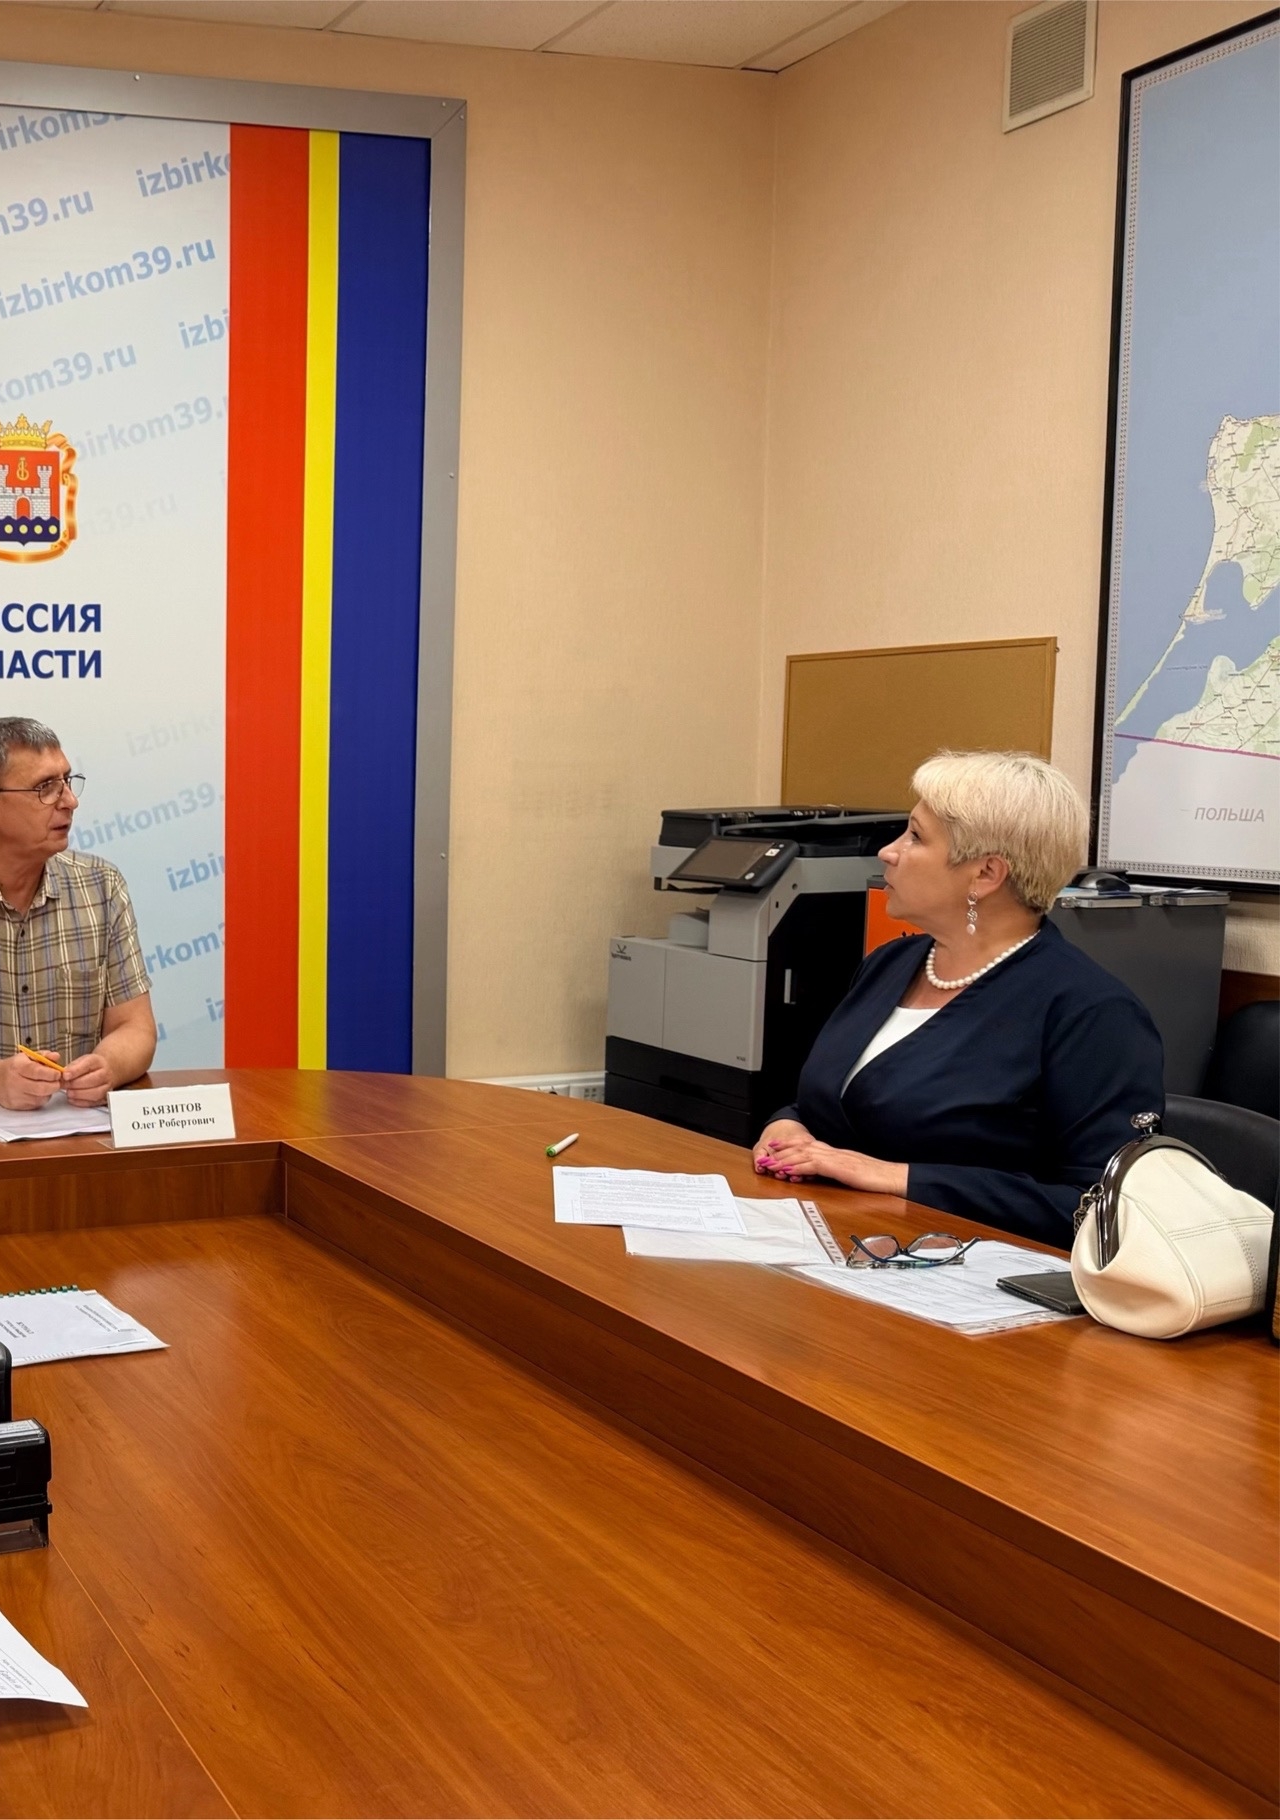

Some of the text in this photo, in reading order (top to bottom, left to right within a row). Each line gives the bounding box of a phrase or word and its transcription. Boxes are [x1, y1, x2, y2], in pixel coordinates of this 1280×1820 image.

[136, 151, 230, 198] izbirk
[1195, 807, 1265, 822] ПОЛЬША
[142, 1102, 202, 1116] БАЯЗИТОВ
[131, 1116, 215, 1130] Олег Робертович
